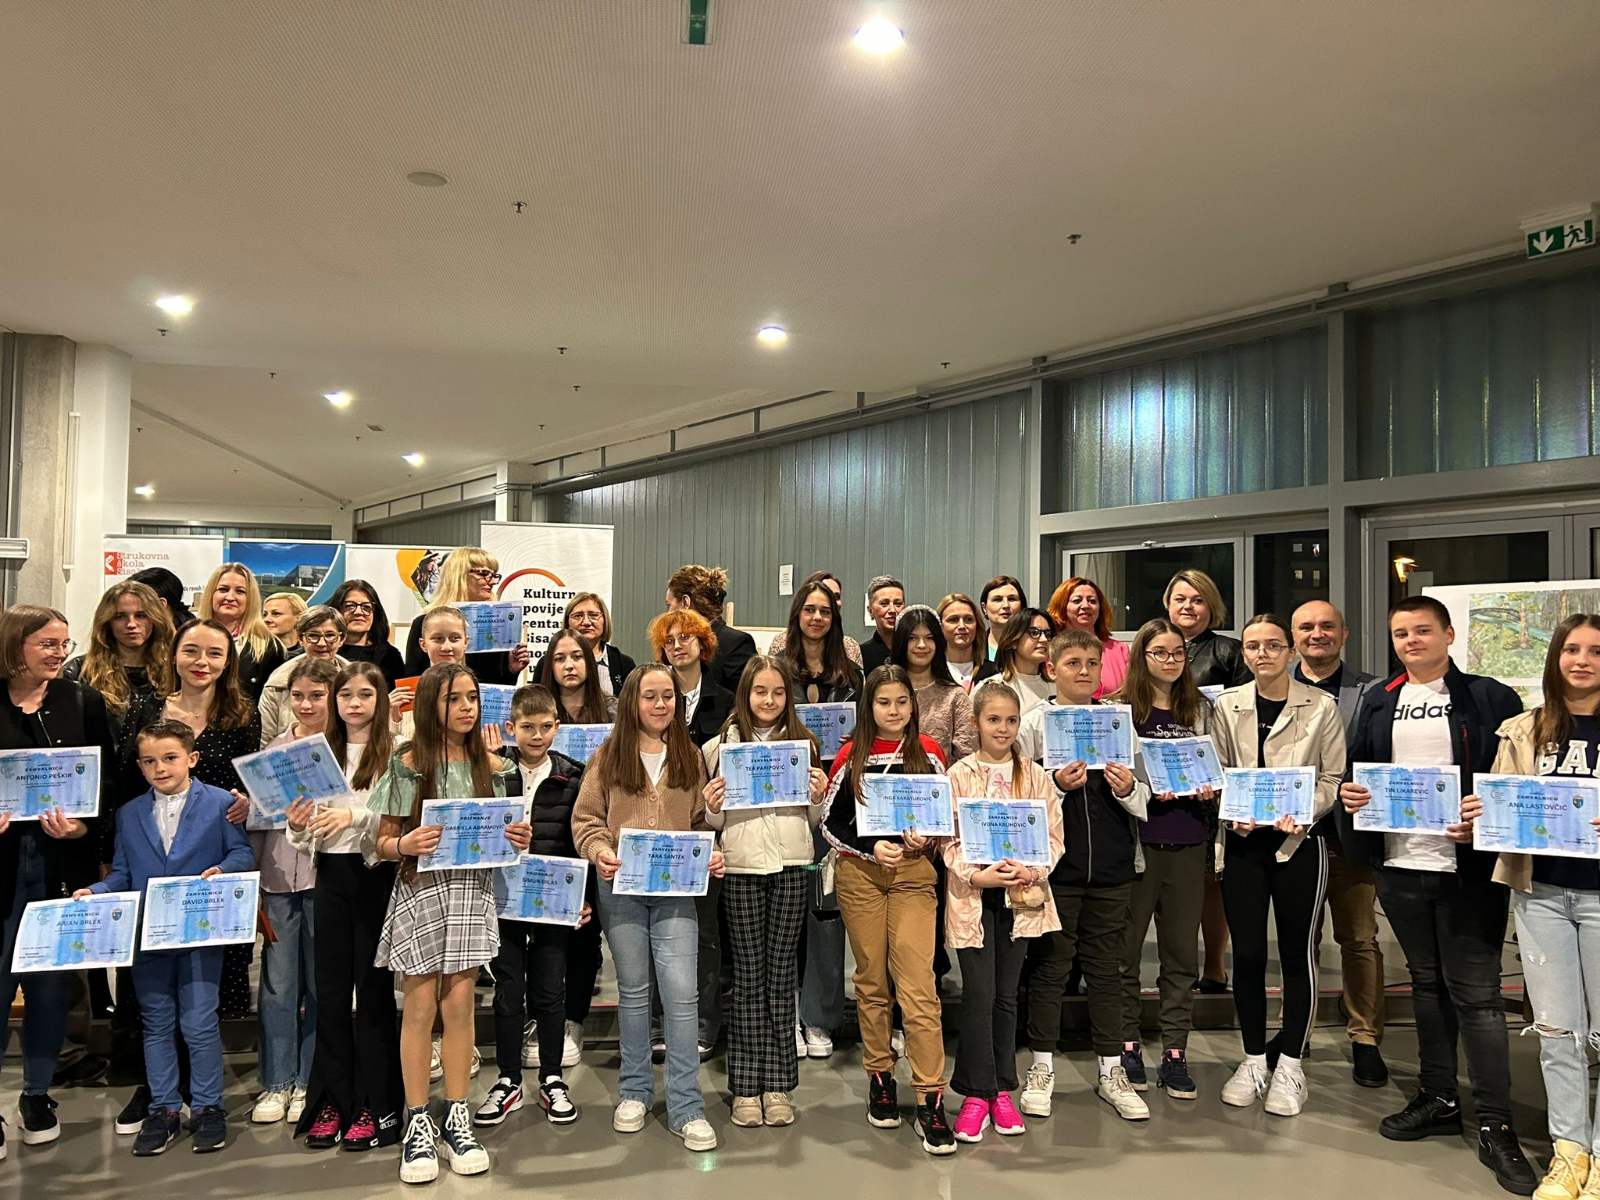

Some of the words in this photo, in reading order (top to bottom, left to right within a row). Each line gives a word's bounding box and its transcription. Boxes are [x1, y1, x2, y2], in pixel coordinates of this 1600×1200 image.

[523, 603, 564, 616] povije
[1393, 702, 1453, 720] didas
[1536, 740, 1600, 778] GA
[16, 773, 48, 781] ANTONIO
[182, 898, 203, 906] DAVID
